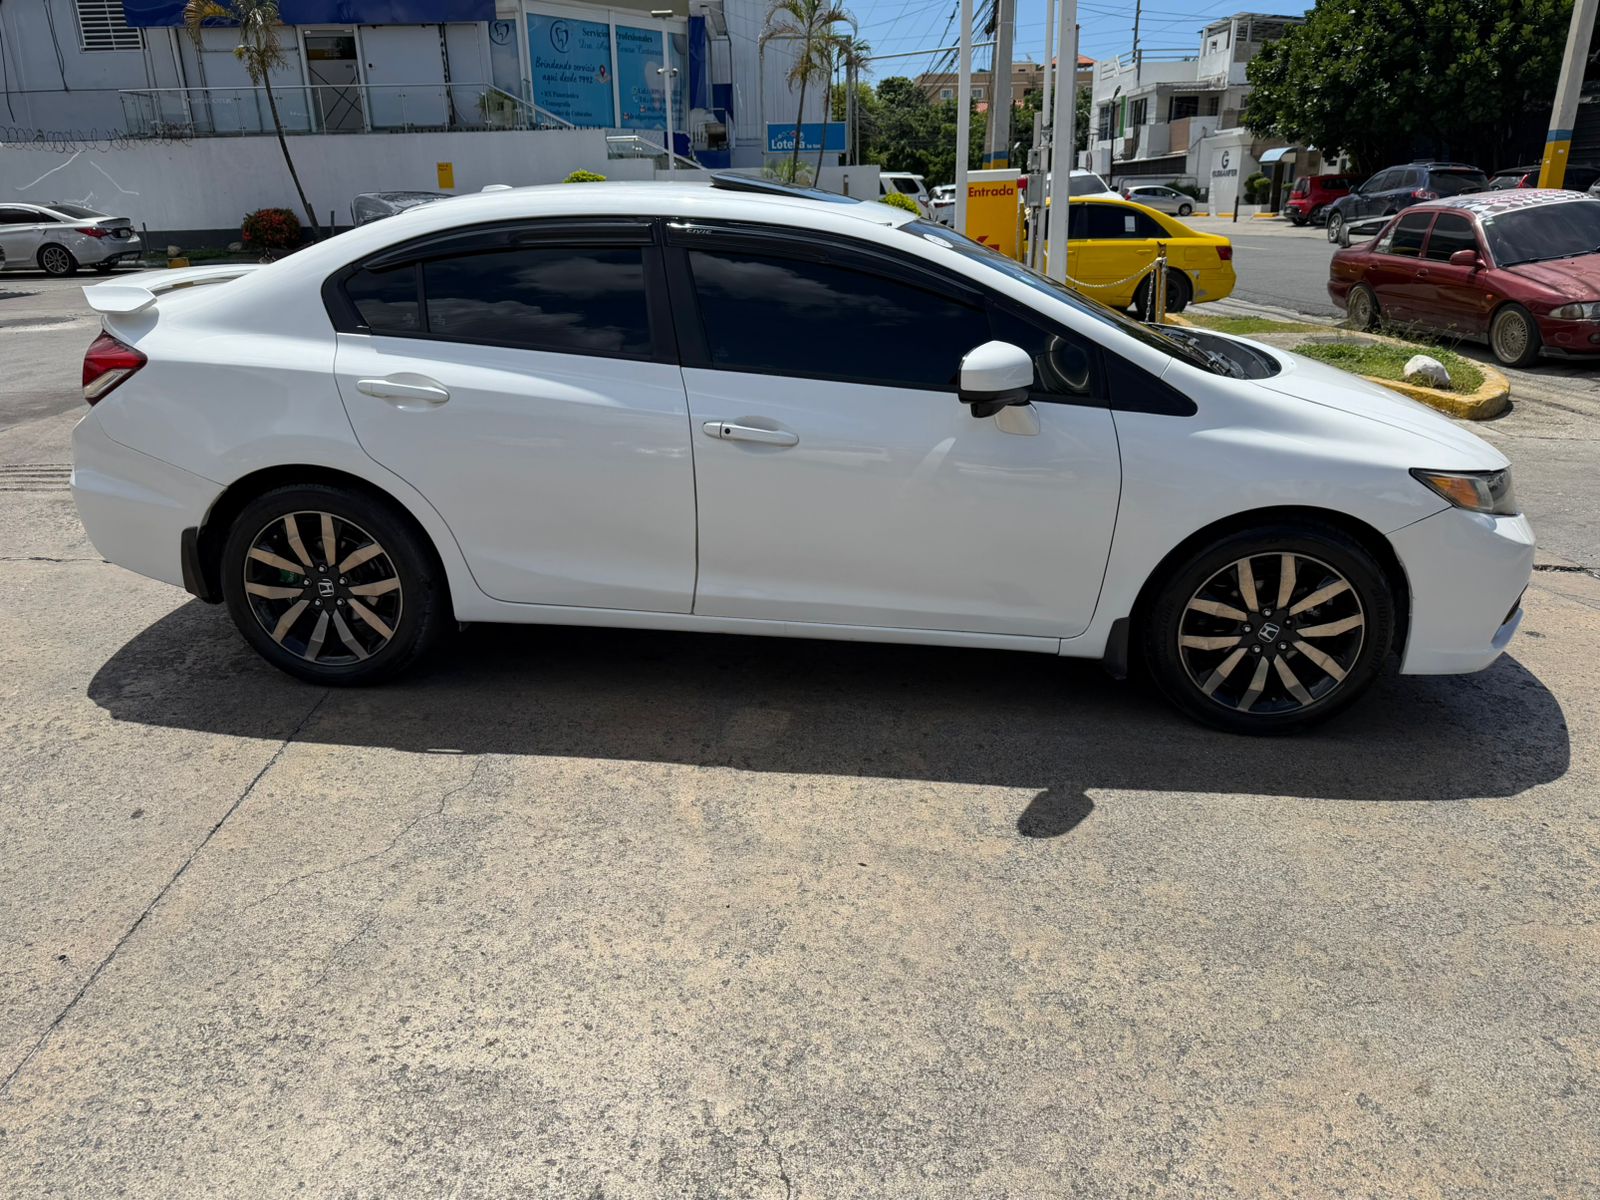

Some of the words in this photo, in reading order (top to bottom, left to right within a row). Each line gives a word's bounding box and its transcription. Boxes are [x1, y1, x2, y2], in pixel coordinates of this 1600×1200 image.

[582, 28, 609, 39] Servicio
[536, 56, 572, 70] Brindando
[968, 184, 1014, 197] Entrada
